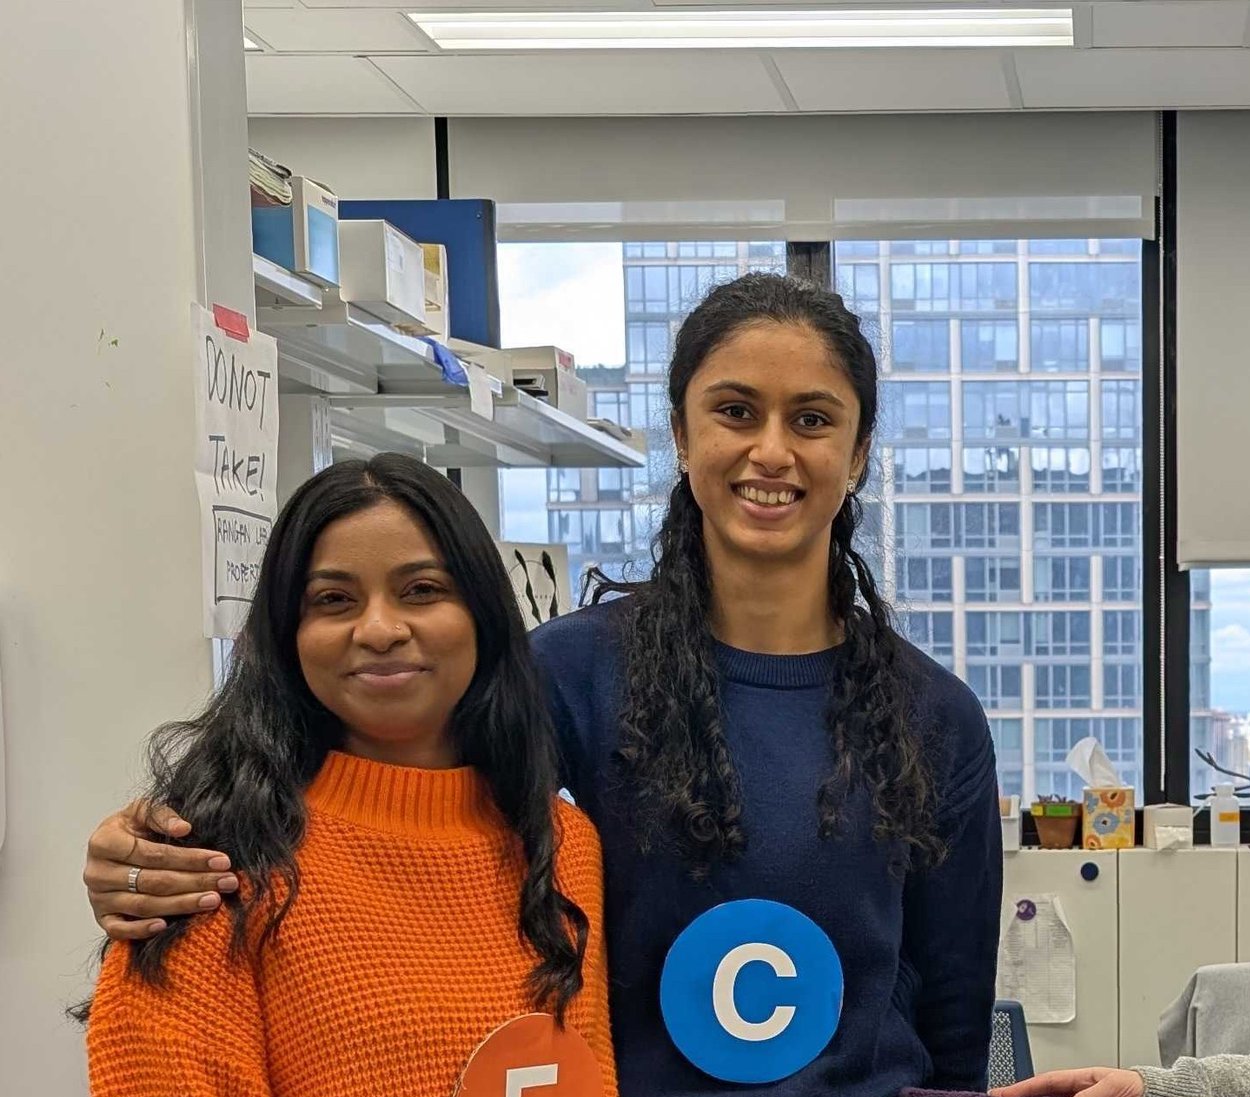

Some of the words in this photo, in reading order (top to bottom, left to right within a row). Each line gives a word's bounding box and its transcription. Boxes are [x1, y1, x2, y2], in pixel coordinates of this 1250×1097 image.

[228, 354, 271, 430] NOT
[208, 435, 267, 502] TAKE!
[226, 560, 260, 583] PROPERT
[712, 942, 798, 1042] C
